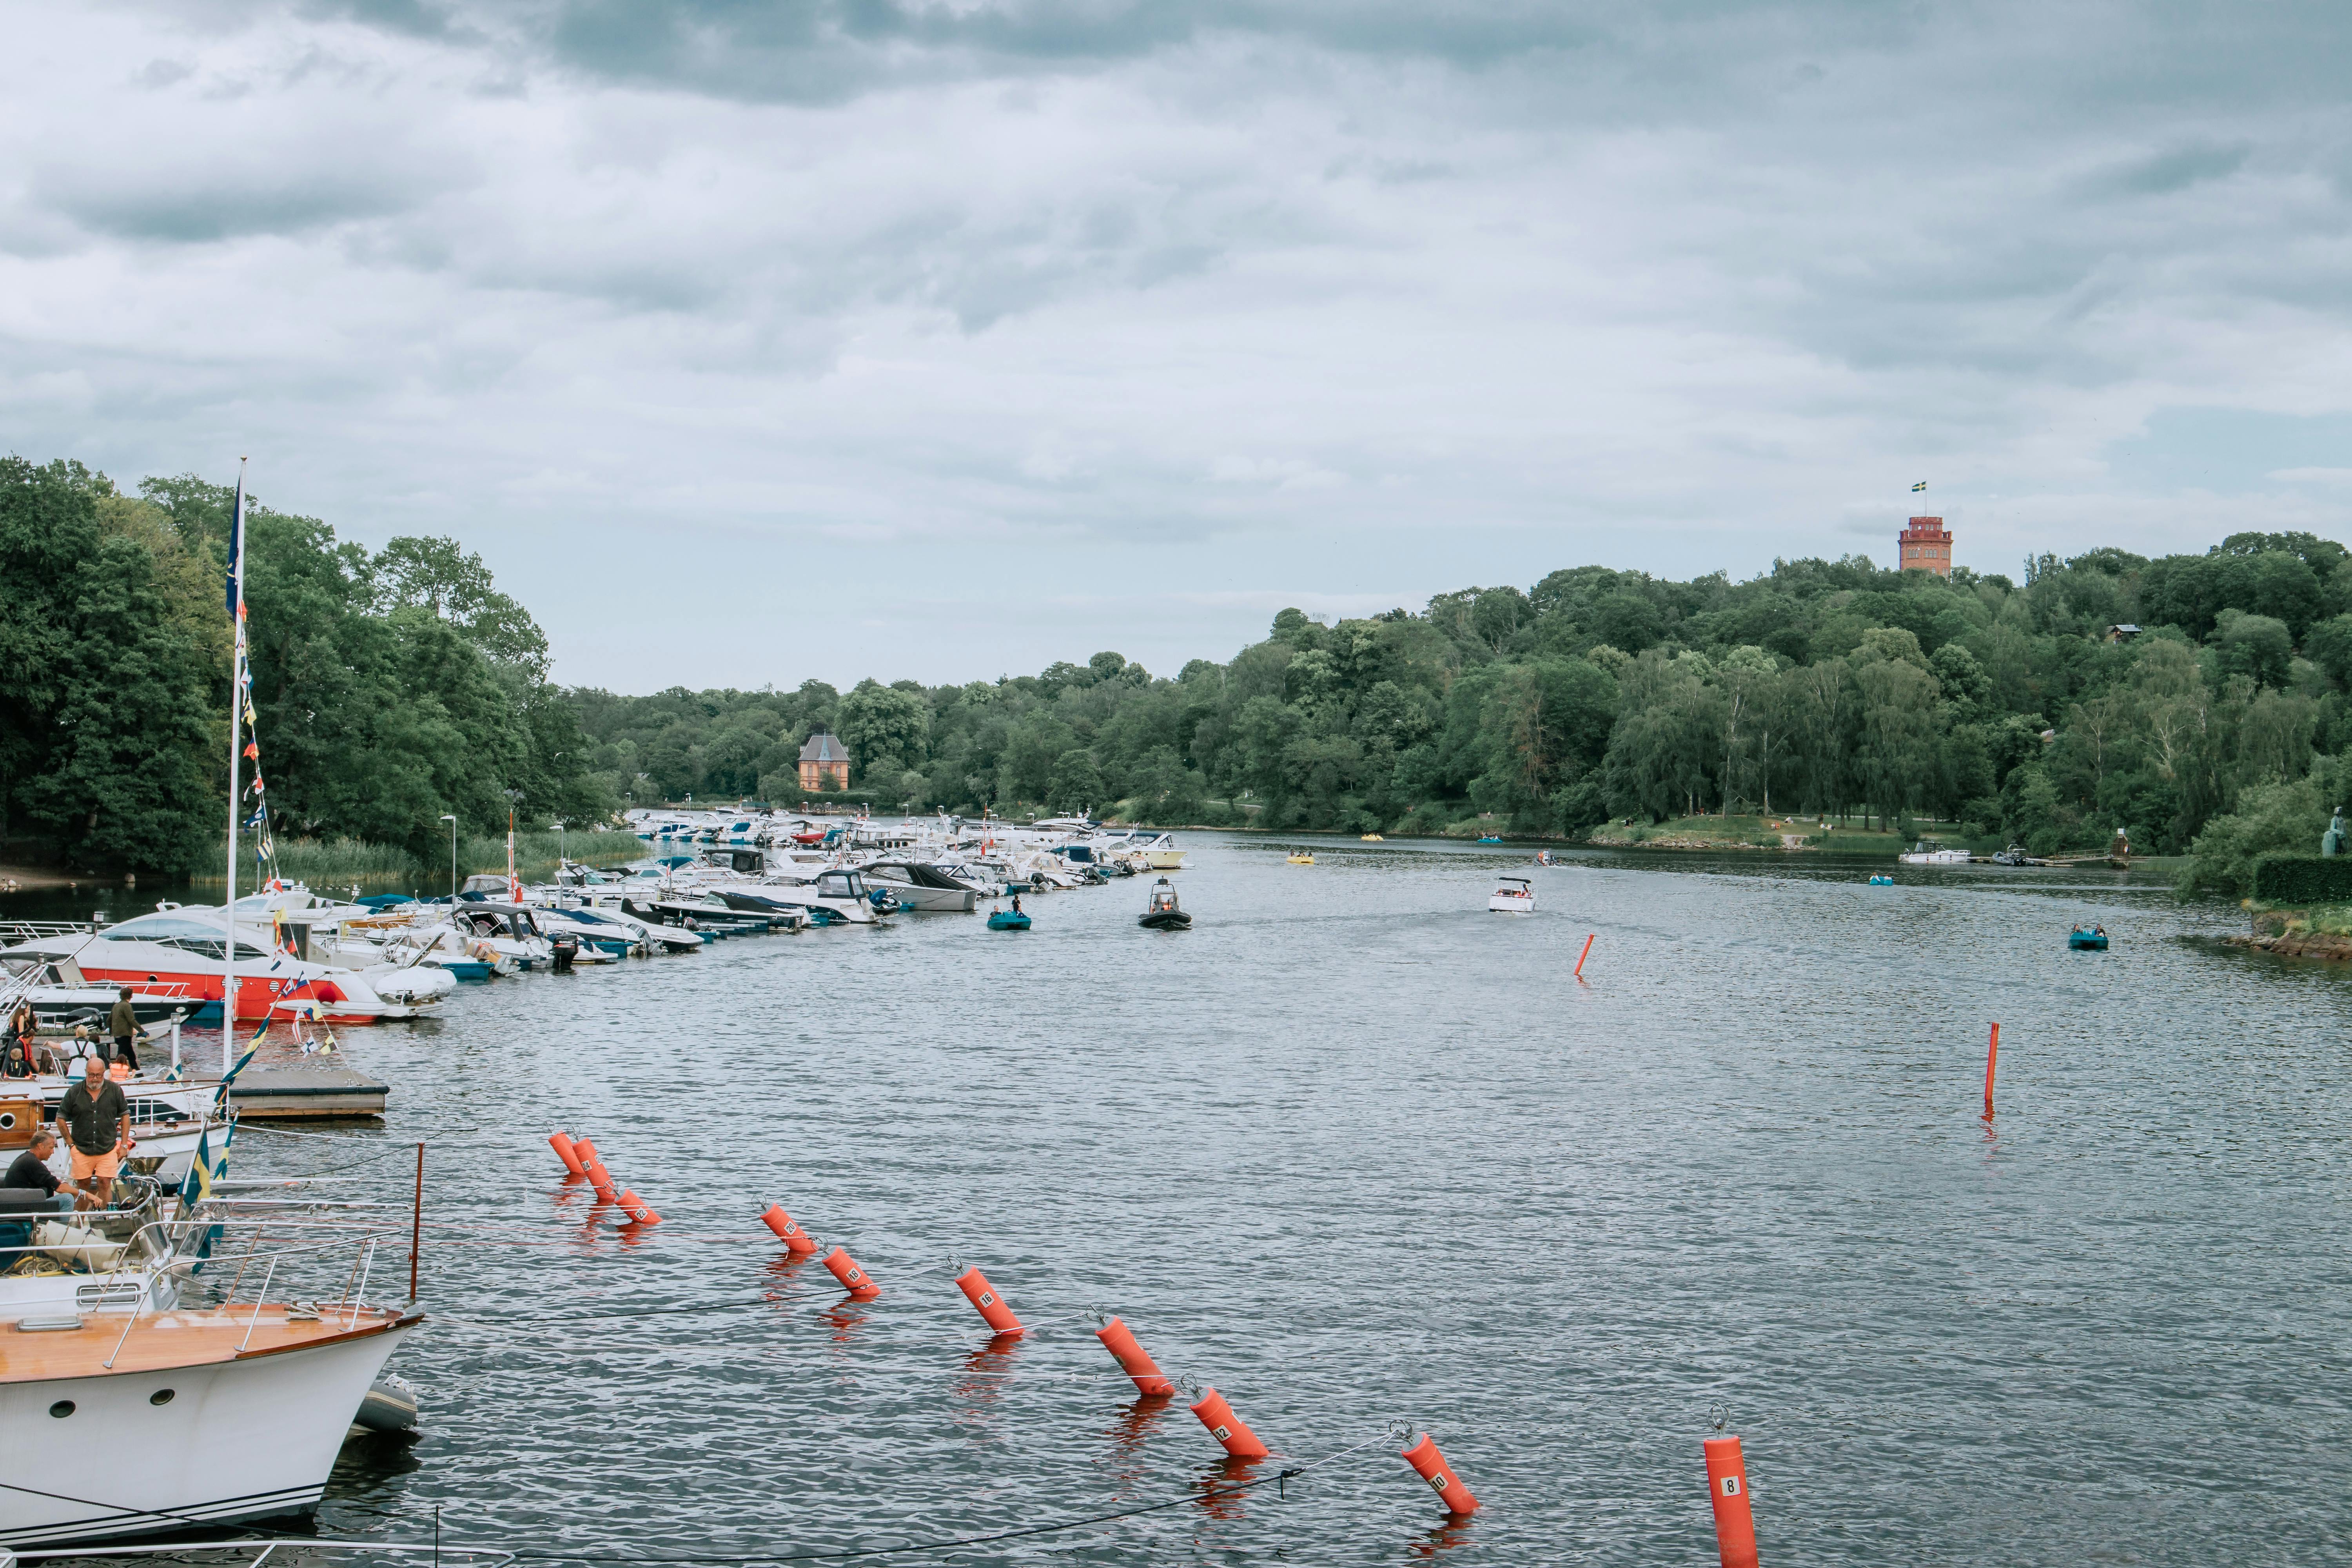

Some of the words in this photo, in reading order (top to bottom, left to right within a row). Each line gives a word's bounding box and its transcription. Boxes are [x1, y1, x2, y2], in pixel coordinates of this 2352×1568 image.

[66, 1016, 92, 1028] MERCURY
[637, 1210, 646, 1218] 22
[786, 1223, 795, 1233] 20
[849, 1270, 858, 1280] 18
[982, 1294, 991, 1304] 16
[1216, 1428, 1229, 1439] 12
[1432, 1476, 1445, 1490] 10
[1727, 1480, 1734, 1492] 8
